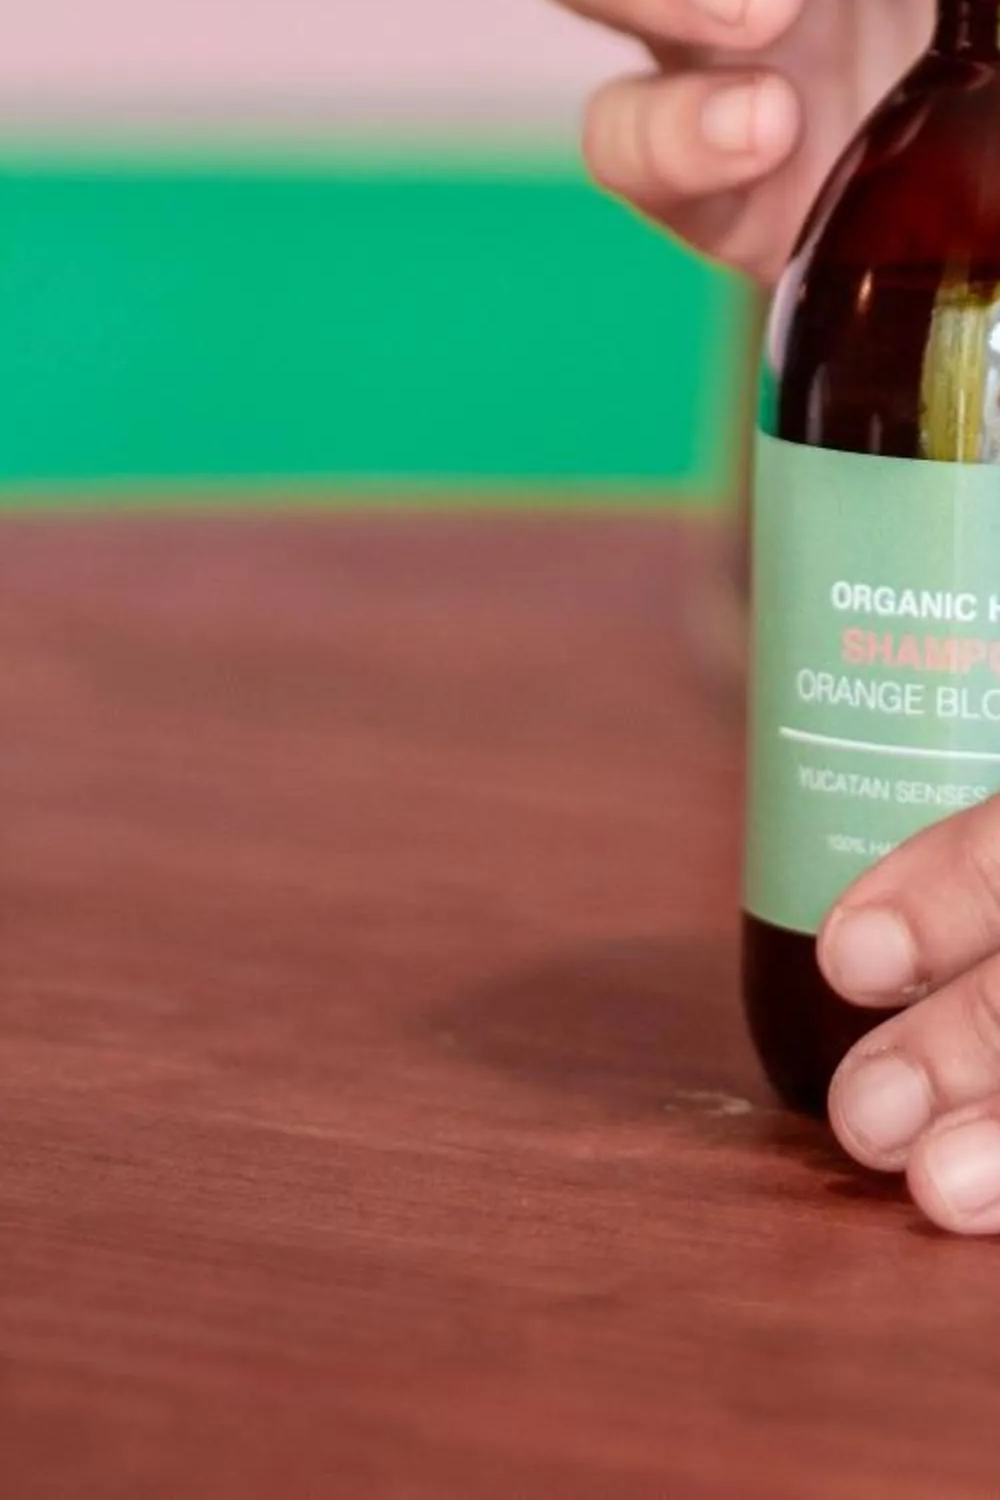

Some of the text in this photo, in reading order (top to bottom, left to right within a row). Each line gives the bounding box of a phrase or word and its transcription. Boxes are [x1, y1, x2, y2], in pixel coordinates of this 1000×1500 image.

[831, 580, 978, 622] ORGANIC
[797, 668, 925, 716] ORANGE
[799, 766, 890, 800] YUCATAN
